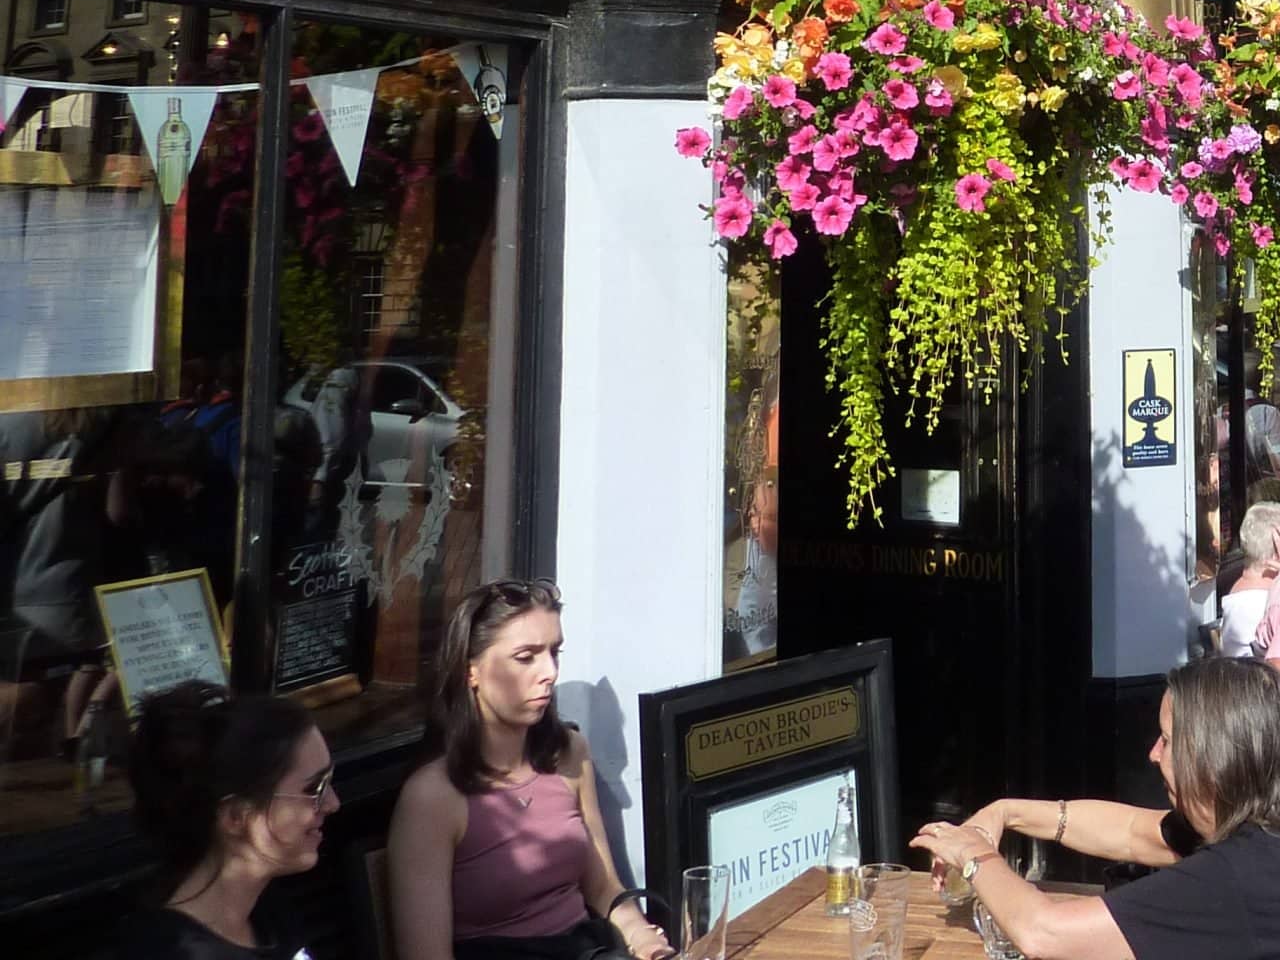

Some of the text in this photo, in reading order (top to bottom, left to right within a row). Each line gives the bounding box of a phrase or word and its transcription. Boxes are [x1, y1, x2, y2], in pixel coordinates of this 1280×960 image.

[1132, 406, 1169, 417] MARQUE
[1138, 399, 1162, 408] CASK
[698, 696, 850, 750] DEACON BRODIE'S
[744, 725, 811, 756] TAVERN
[759, 828, 832, 877] FESTIVA
